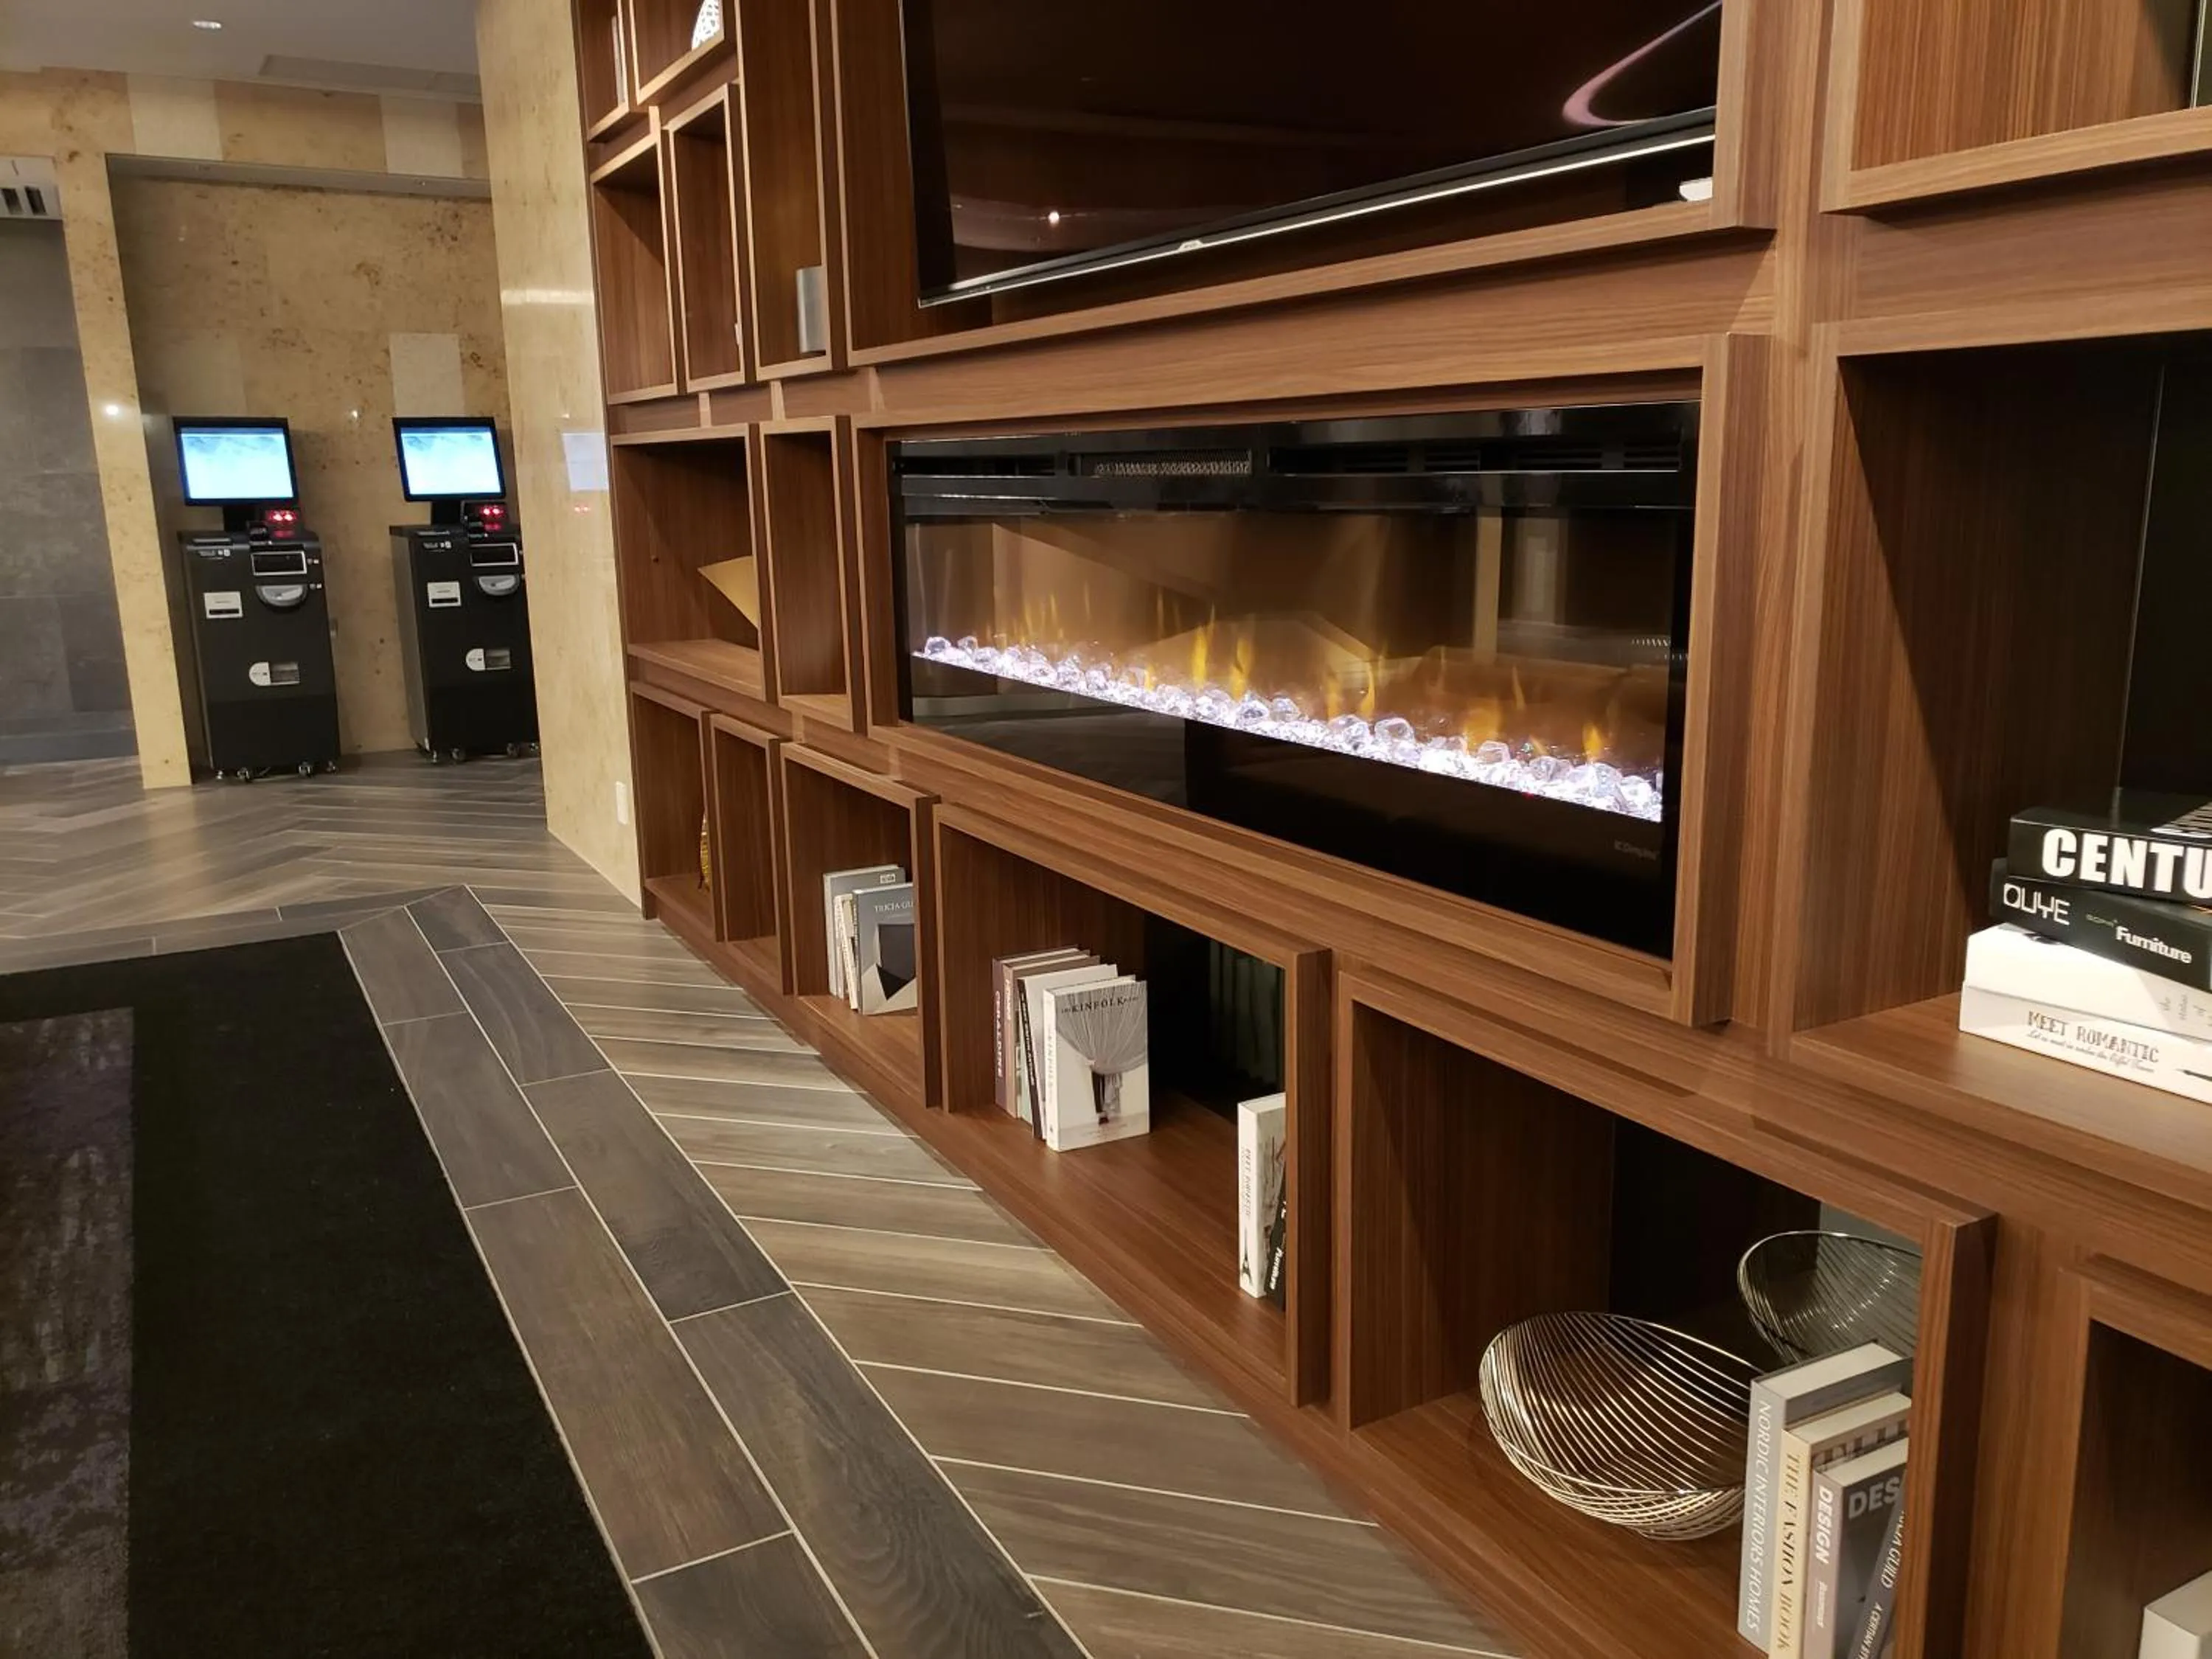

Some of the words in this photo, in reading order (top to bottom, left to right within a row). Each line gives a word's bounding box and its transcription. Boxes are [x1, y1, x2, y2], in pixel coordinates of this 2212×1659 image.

[2042, 829, 2212, 899] CENTU
[2115, 925, 2192, 964] Furniture
[1072, 995, 1124, 1014] KINFOLK
[2028, 1011, 2069, 1036] MEET
[2076, 1026, 2159, 1063] ROMANTIC
[1755, 1400, 1772, 1475] NORDIC
[1785, 1453, 1801, 1497] THE
[1848, 1477, 1900, 1519] DES
[1750, 1474, 1768, 1566] INTERIORS
[1781, 1500, 1798, 1586] FASHION
[1815, 1485, 1833, 1564] DESIGN
[1881, 1548, 1901, 1589] GUILD
[1746, 1567, 1762, 1635] HOMES
[1777, 1592, 1792, 1651] BOOK
